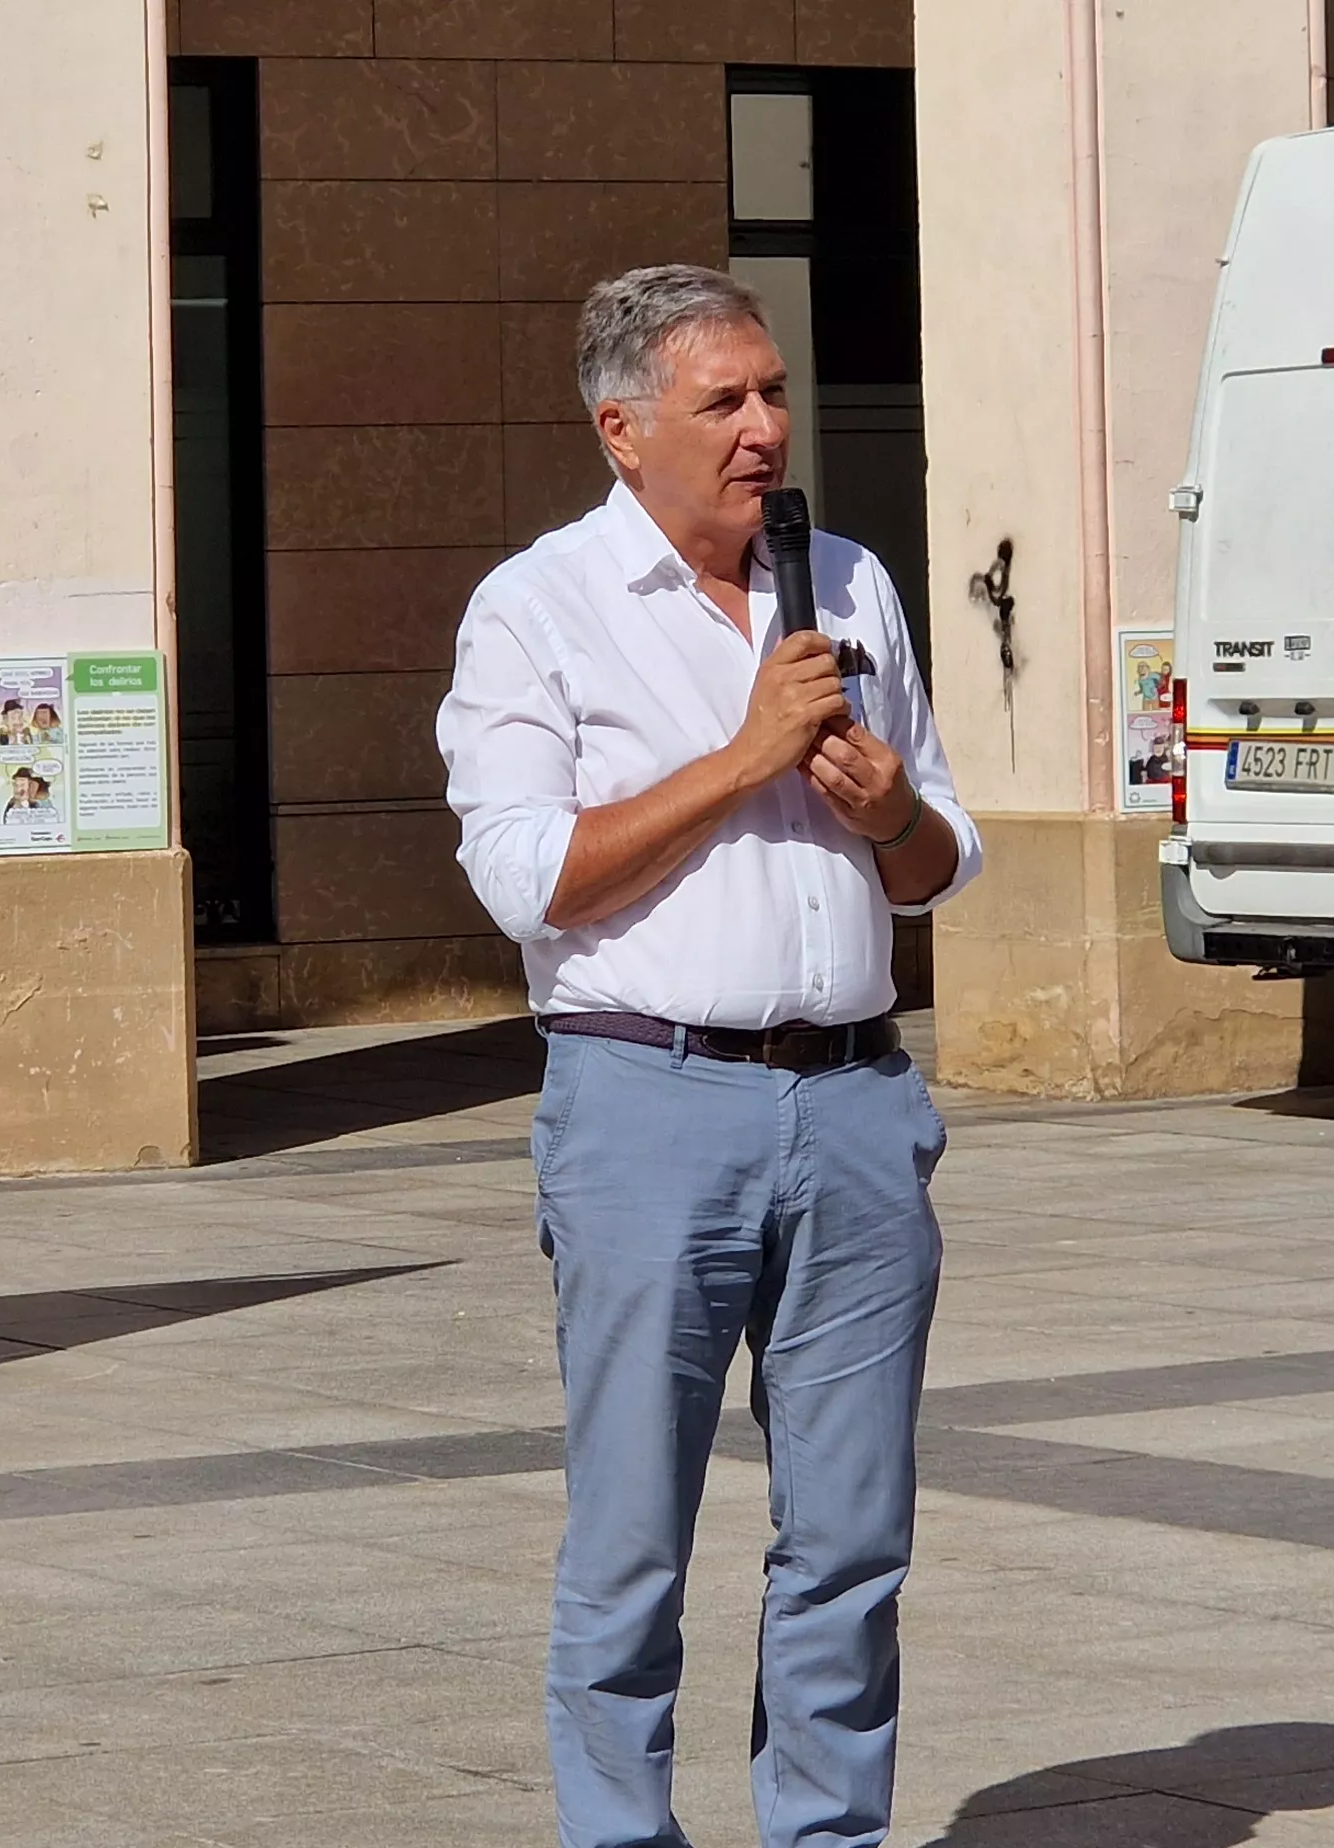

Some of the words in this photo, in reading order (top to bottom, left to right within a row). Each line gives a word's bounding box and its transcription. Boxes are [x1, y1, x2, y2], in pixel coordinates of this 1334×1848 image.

[1214, 641, 1274, 657] TRANSIT
[89, 664, 142, 675] Confrontar
[89, 678, 104, 688] los
[108, 677, 142, 688] delirios
[1241, 745, 1287, 778] 4523
[1294, 747, 1334, 780] FRT
